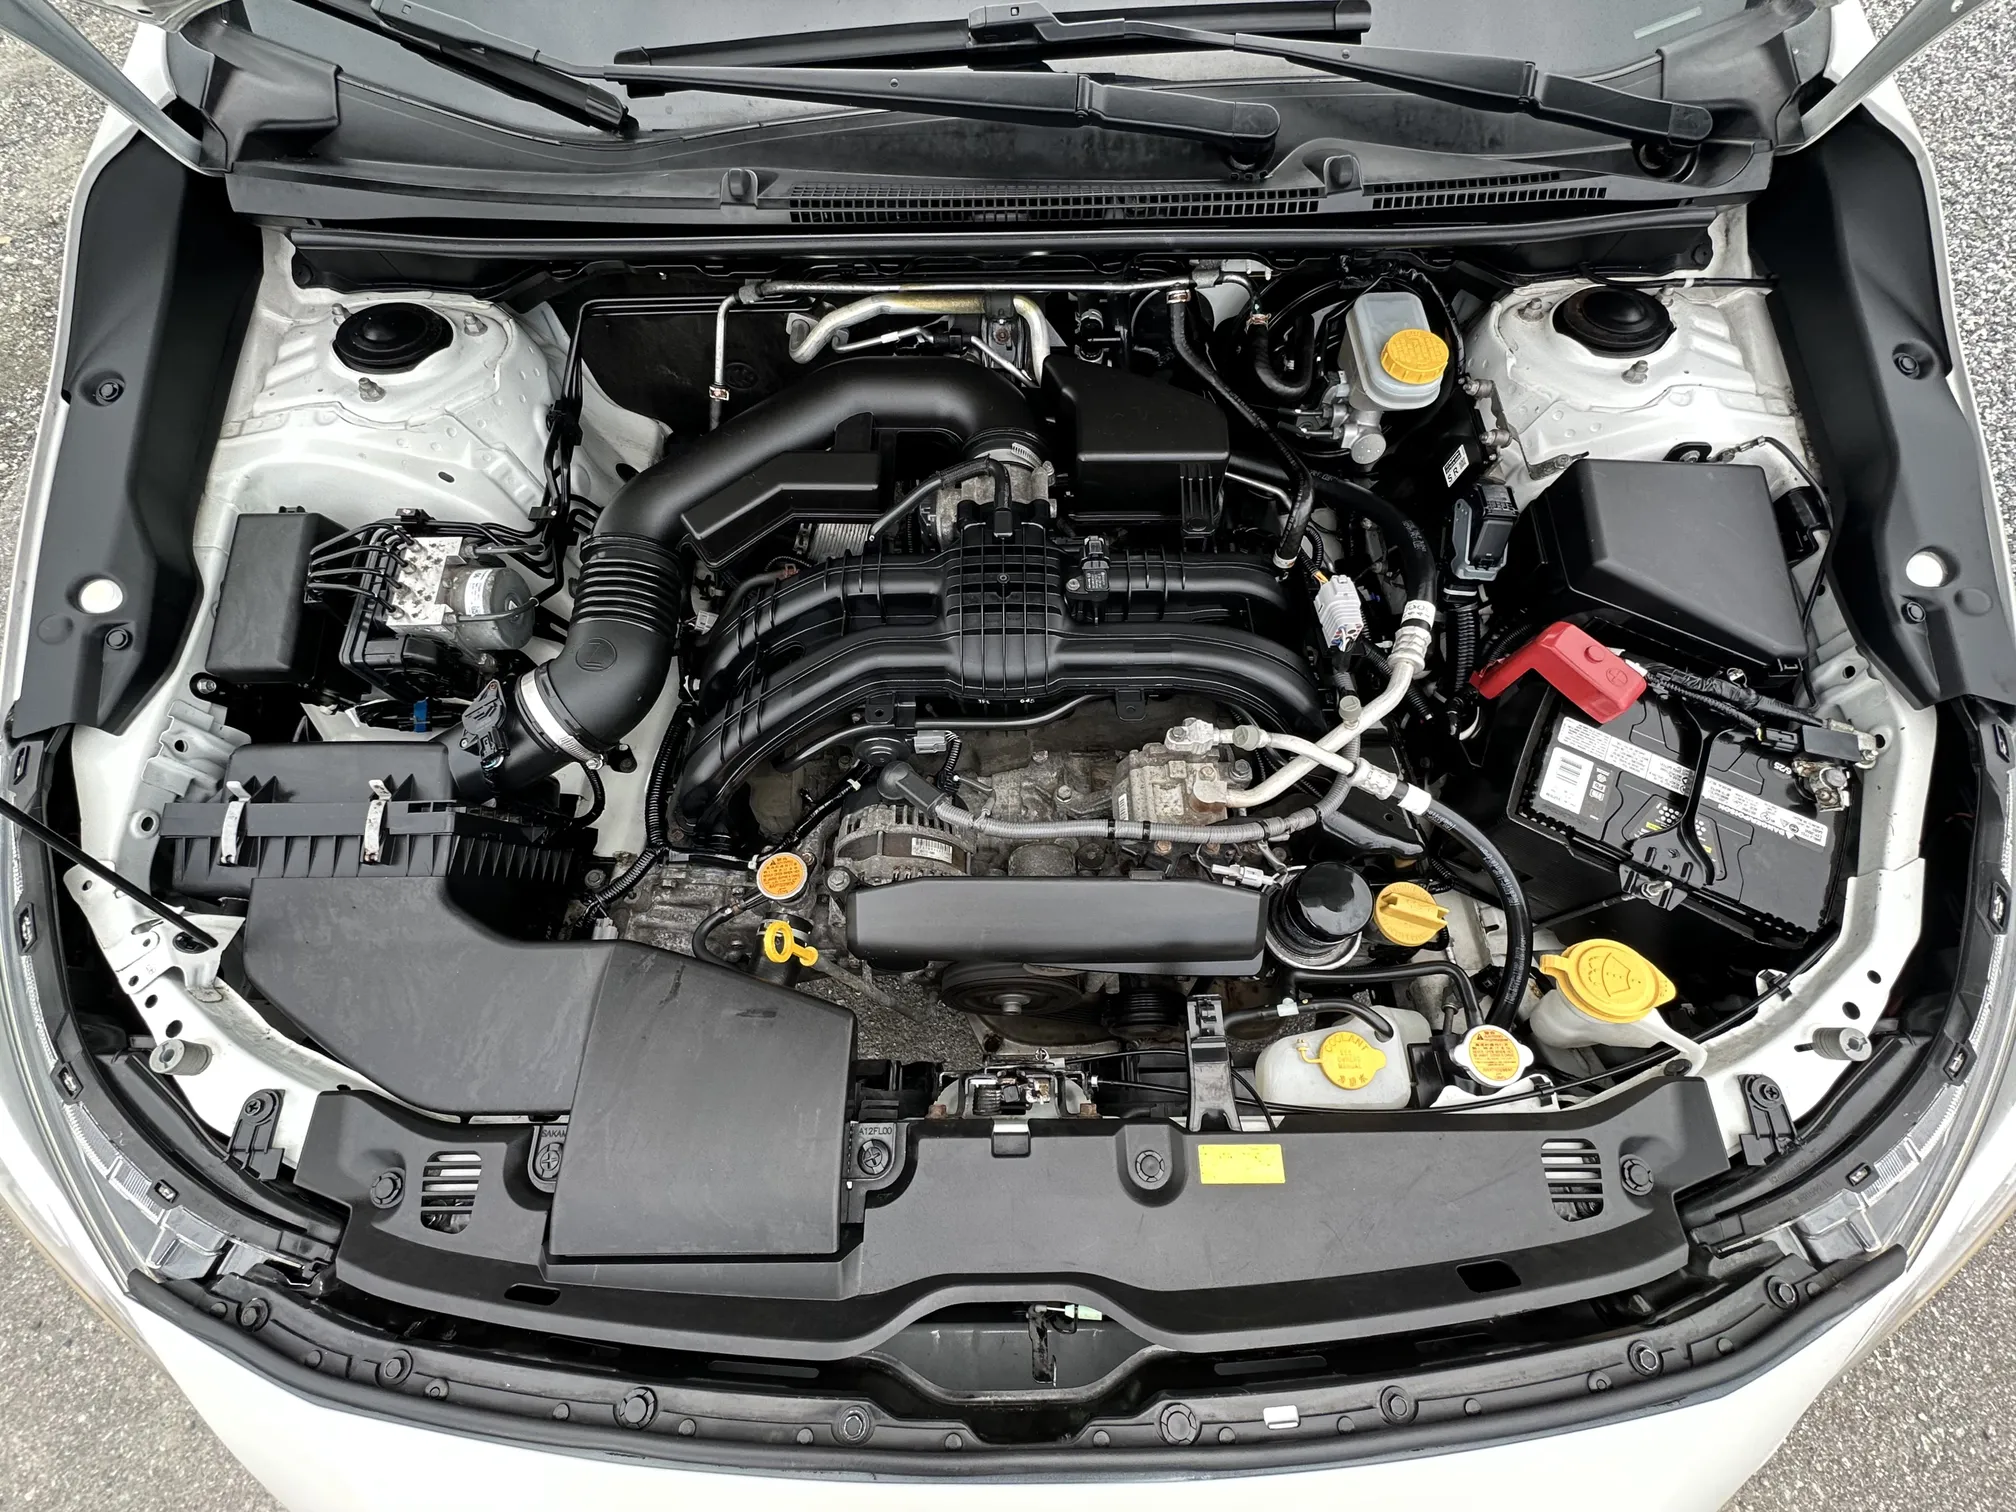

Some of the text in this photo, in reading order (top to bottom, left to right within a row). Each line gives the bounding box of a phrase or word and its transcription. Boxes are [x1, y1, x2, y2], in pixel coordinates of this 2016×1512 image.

[1772, 760, 1792, 775] 6/25
[1324, 1034, 1368, 1052] COOLANT
[859, 1126, 893, 1136] A12FL00
